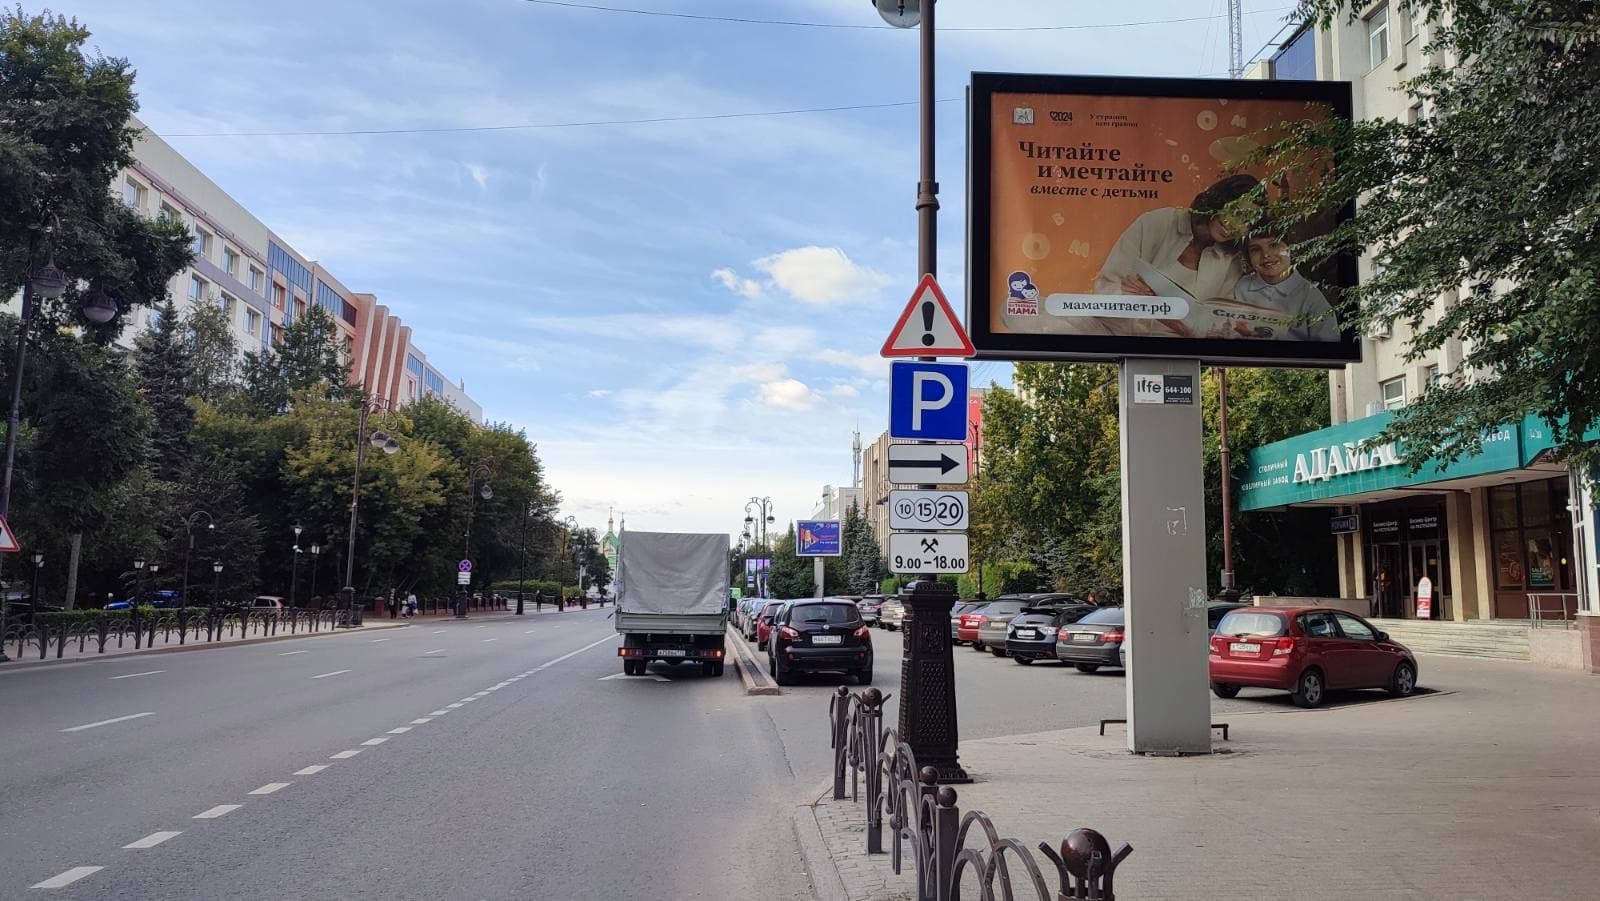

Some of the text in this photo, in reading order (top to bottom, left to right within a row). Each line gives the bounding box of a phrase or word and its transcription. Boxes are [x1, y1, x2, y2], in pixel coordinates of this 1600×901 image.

[1019, 141, 1121, 161] Читайте
[1037, 163, 1173, 183] и мечтайте
[1030, 185, 1159, 199] вместе с детьми
[1008, 307, 1037, 315] МАМА
[1062, 302, 1171, 315] мамачитает.рф
[899, 502, 960, 519] 10 15 20
